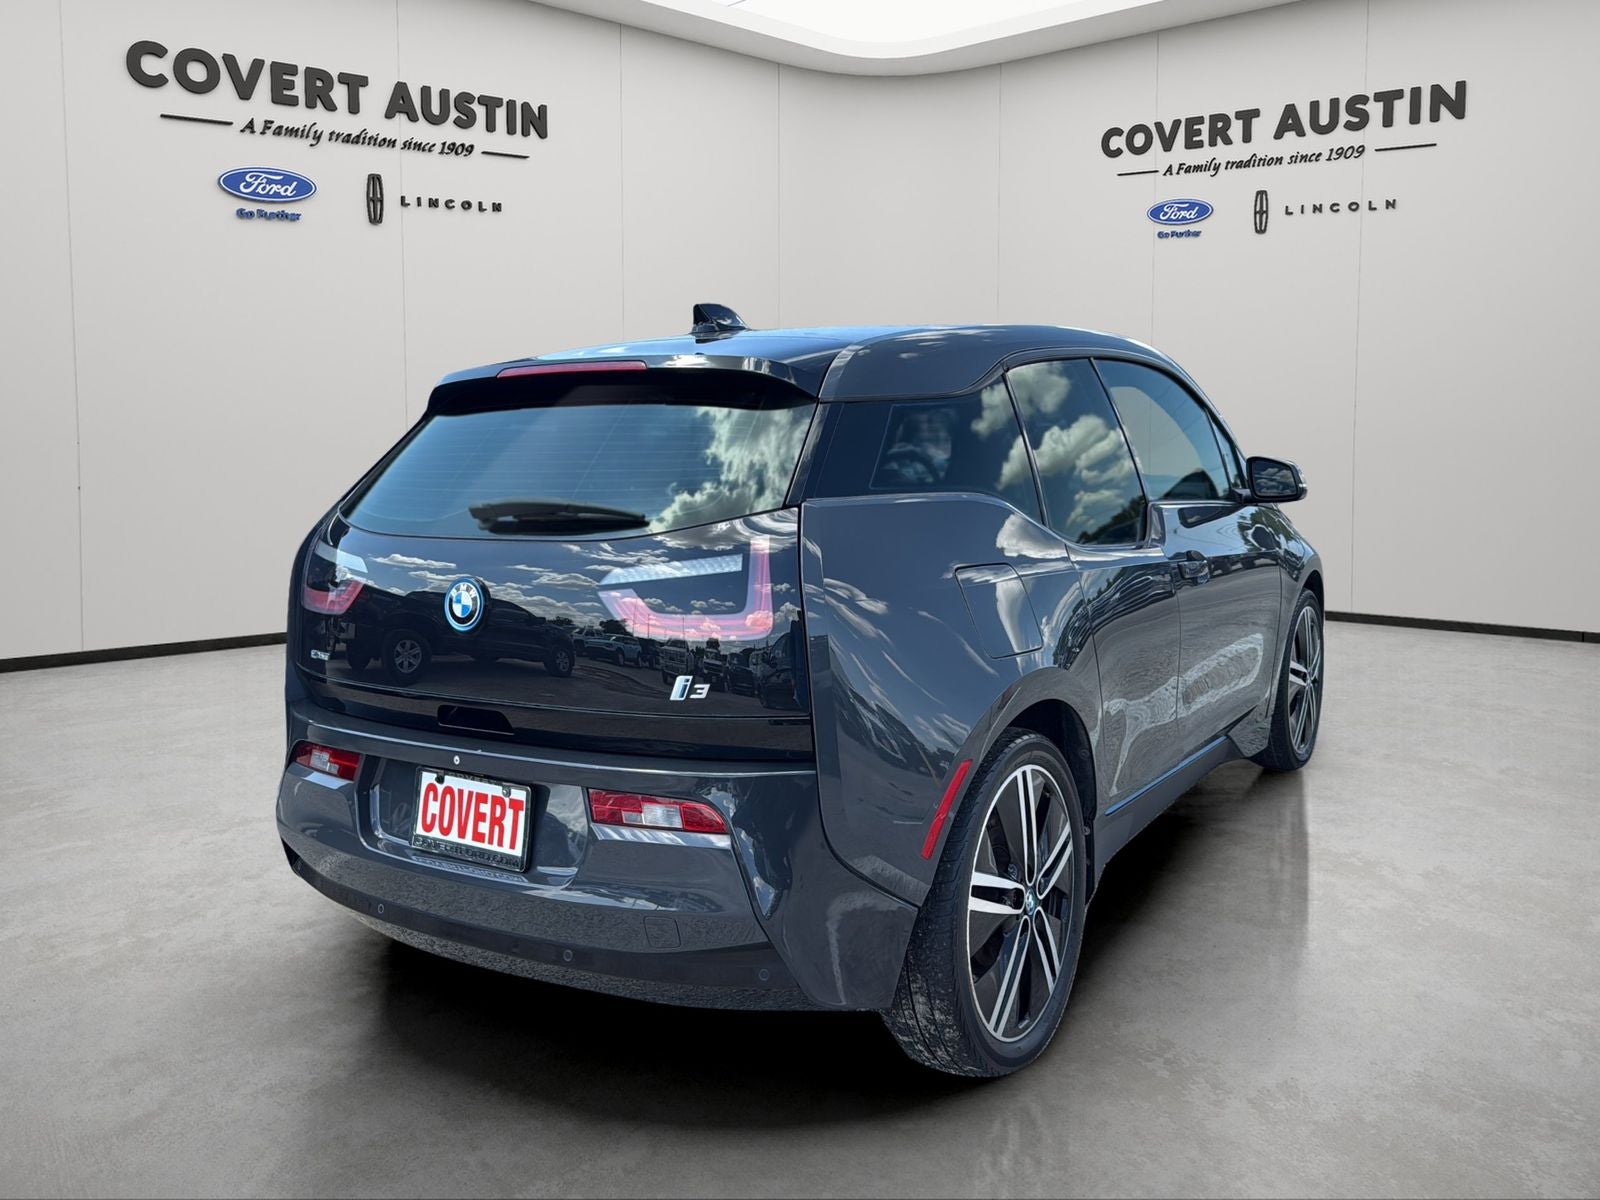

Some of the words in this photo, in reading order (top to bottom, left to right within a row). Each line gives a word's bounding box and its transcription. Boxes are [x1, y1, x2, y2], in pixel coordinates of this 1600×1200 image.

[126, 40, 369, 116] COVERT
[385, 80, 548, 139] AUSTIN
[1100, 108, 1261, 159] COVERT
[1273, 80, 1467, 141] AUSTIN
[239, 117, 257, 135] A
[259, 119, 324, 147] Family
[328, 128, 398, 149] tradition
[400, 137, 436, 153] since
[438, 141, 475, 157] 1909
[1162, 163, 1174, 177] A
[1175, 157, 1222, 178] Family
[1224, 153, 1284, 171] tradition
[1287, 151, 1323, 165] since
[1325, 144, 1366, 162] 1909
[239, 171, 298, 197] Ford
[400, 195, 502, 213] LINCOLN
[1160, 203, 1199, 220] Ford
[1284, 198, 1397, 216] LINCOLN
[670, 675, 710, 700] i3
[421, 782, 525, 851] COVERT
